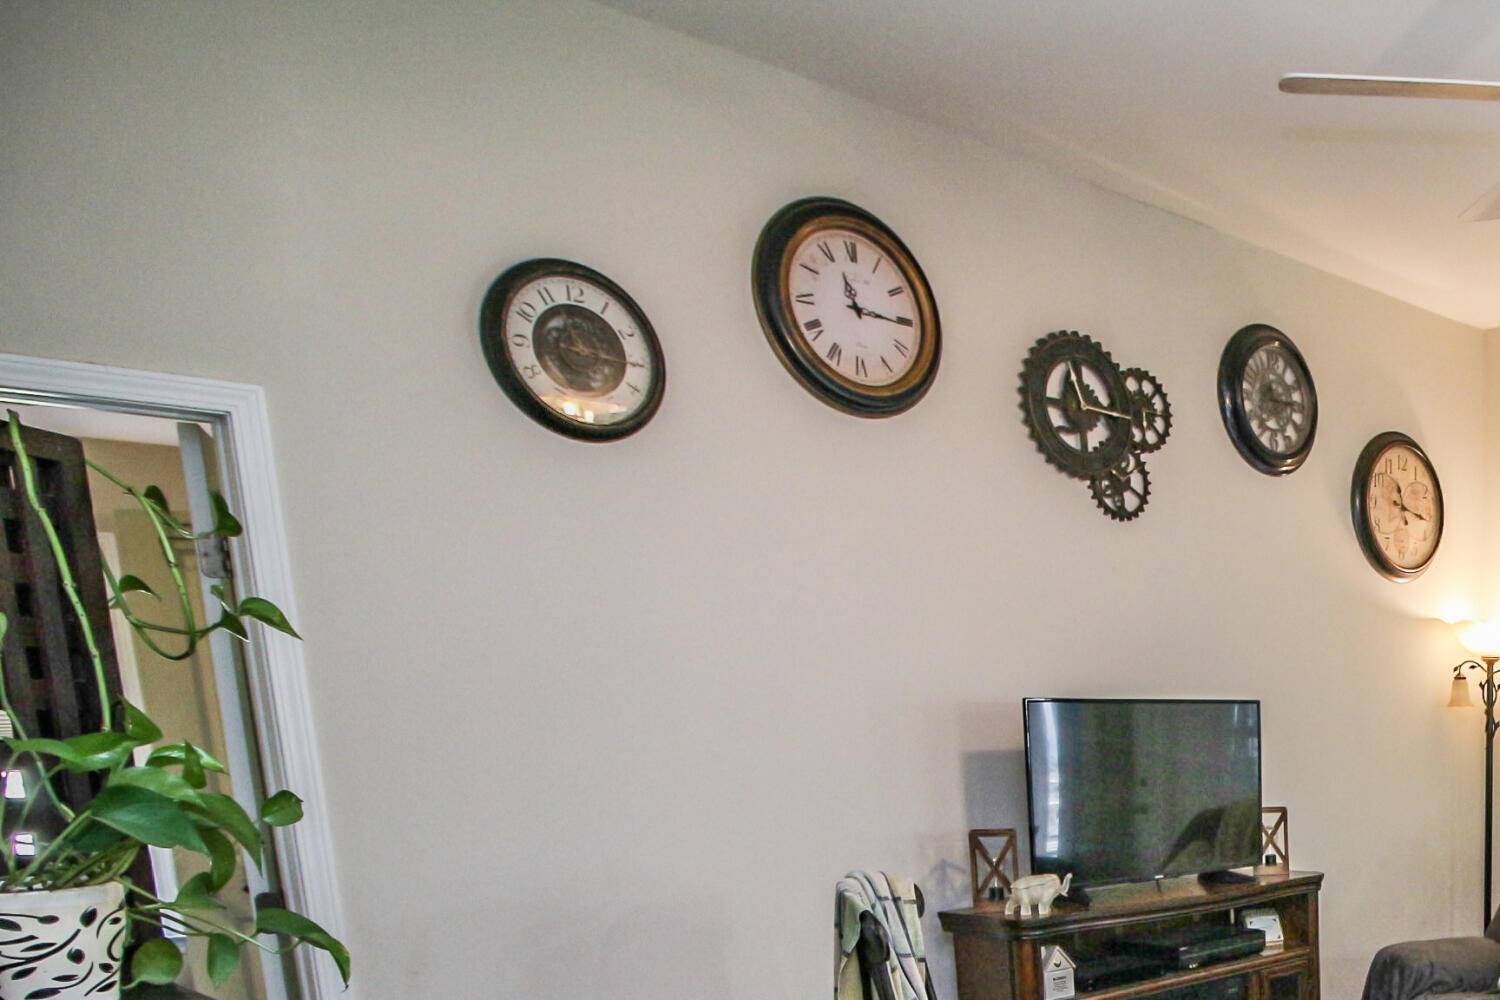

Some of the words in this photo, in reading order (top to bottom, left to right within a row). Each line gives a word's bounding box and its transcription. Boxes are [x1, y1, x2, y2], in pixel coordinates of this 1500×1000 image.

[537, 287, 556, 305] 11
[566, 285, 585, 304] 12
[515, 302, 537, 323] 10
[601, 302, 609, 315] 1
[511, 333, 529, 348] 9
[618, 326, 635, 341] 2
[1384, 457, 1392, 474] 11
[1397, 454, 1408, 472] 12
